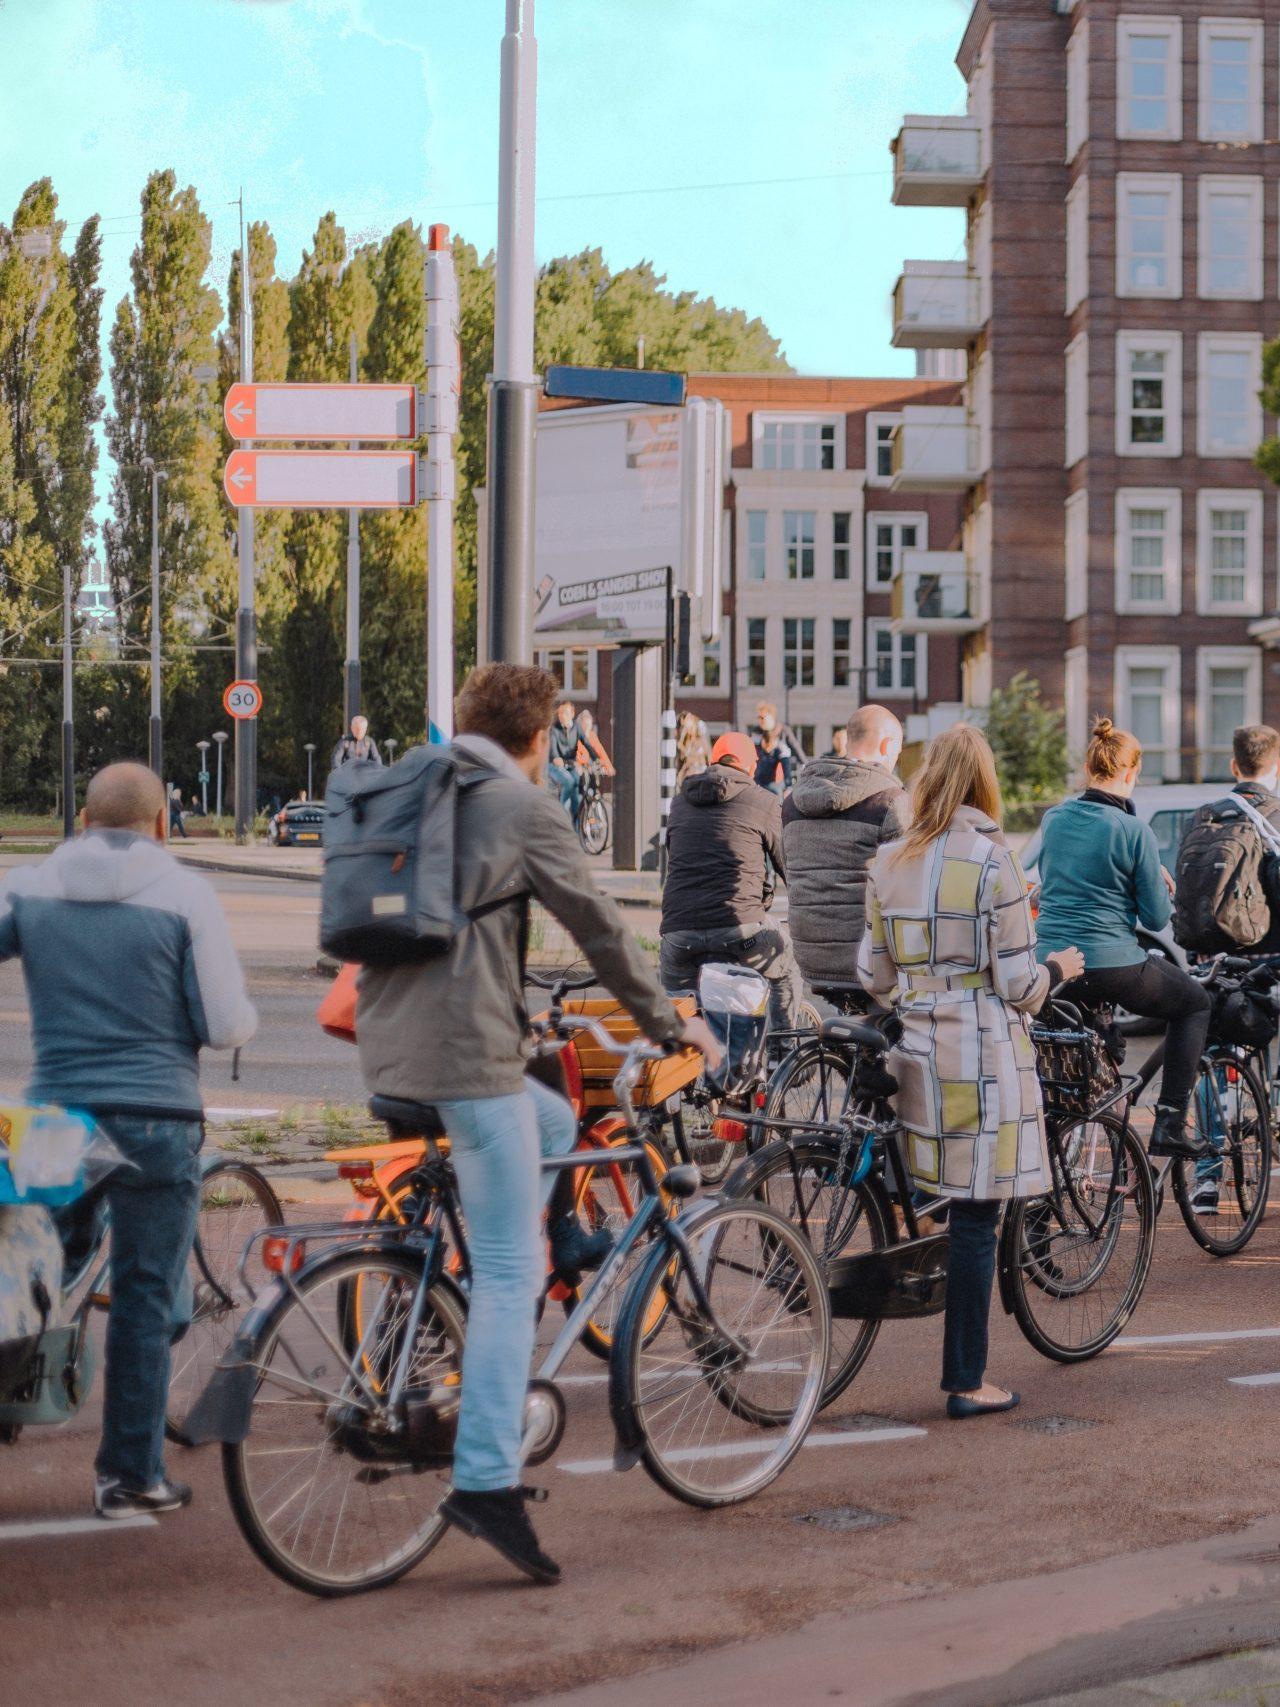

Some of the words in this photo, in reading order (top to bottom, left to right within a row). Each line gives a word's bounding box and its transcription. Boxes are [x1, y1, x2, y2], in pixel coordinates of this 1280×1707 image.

[561, 583, 587, 604] COEN
[588, 582, 597, 599] &
[597, 574, 637, 596] SANDER
[232, 692, 254, 706] 30
